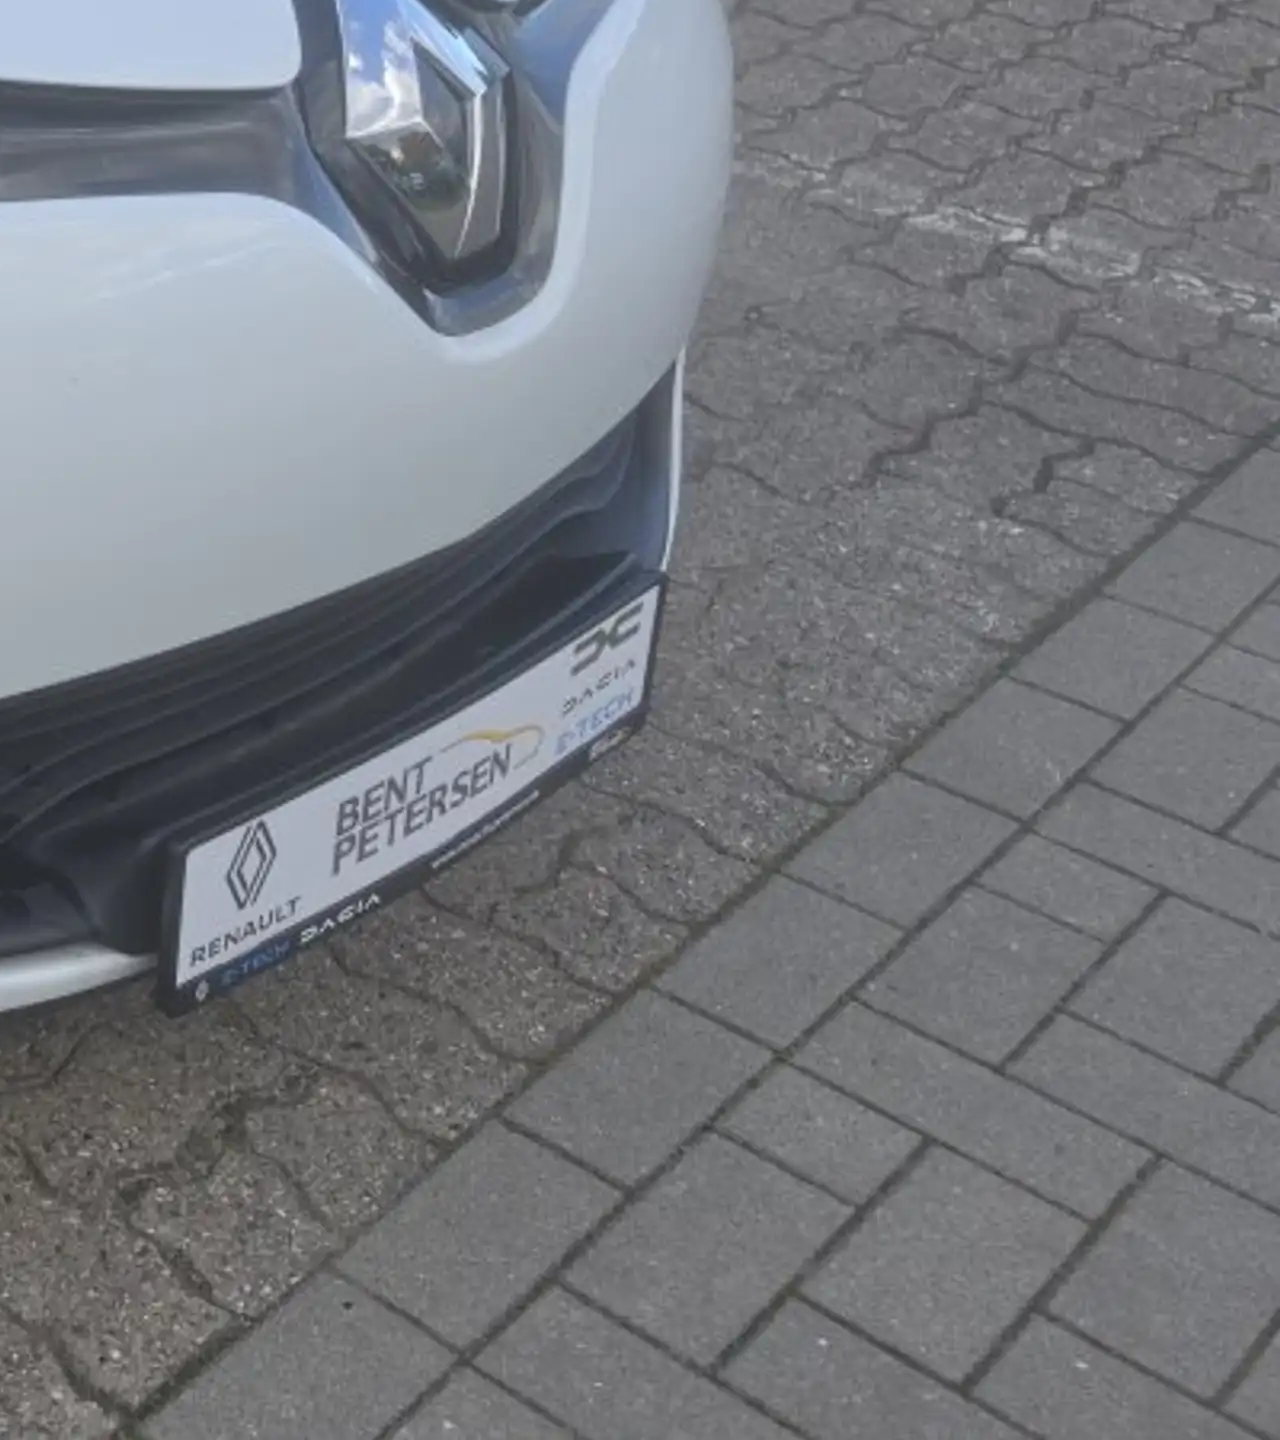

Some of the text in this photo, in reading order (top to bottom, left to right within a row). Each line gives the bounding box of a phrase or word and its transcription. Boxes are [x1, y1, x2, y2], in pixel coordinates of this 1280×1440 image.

[331, 742, 511, 876] PETERSEN
[336, 755, 434, 837] BENT
[190, 895, 302, 967] RENAULT
